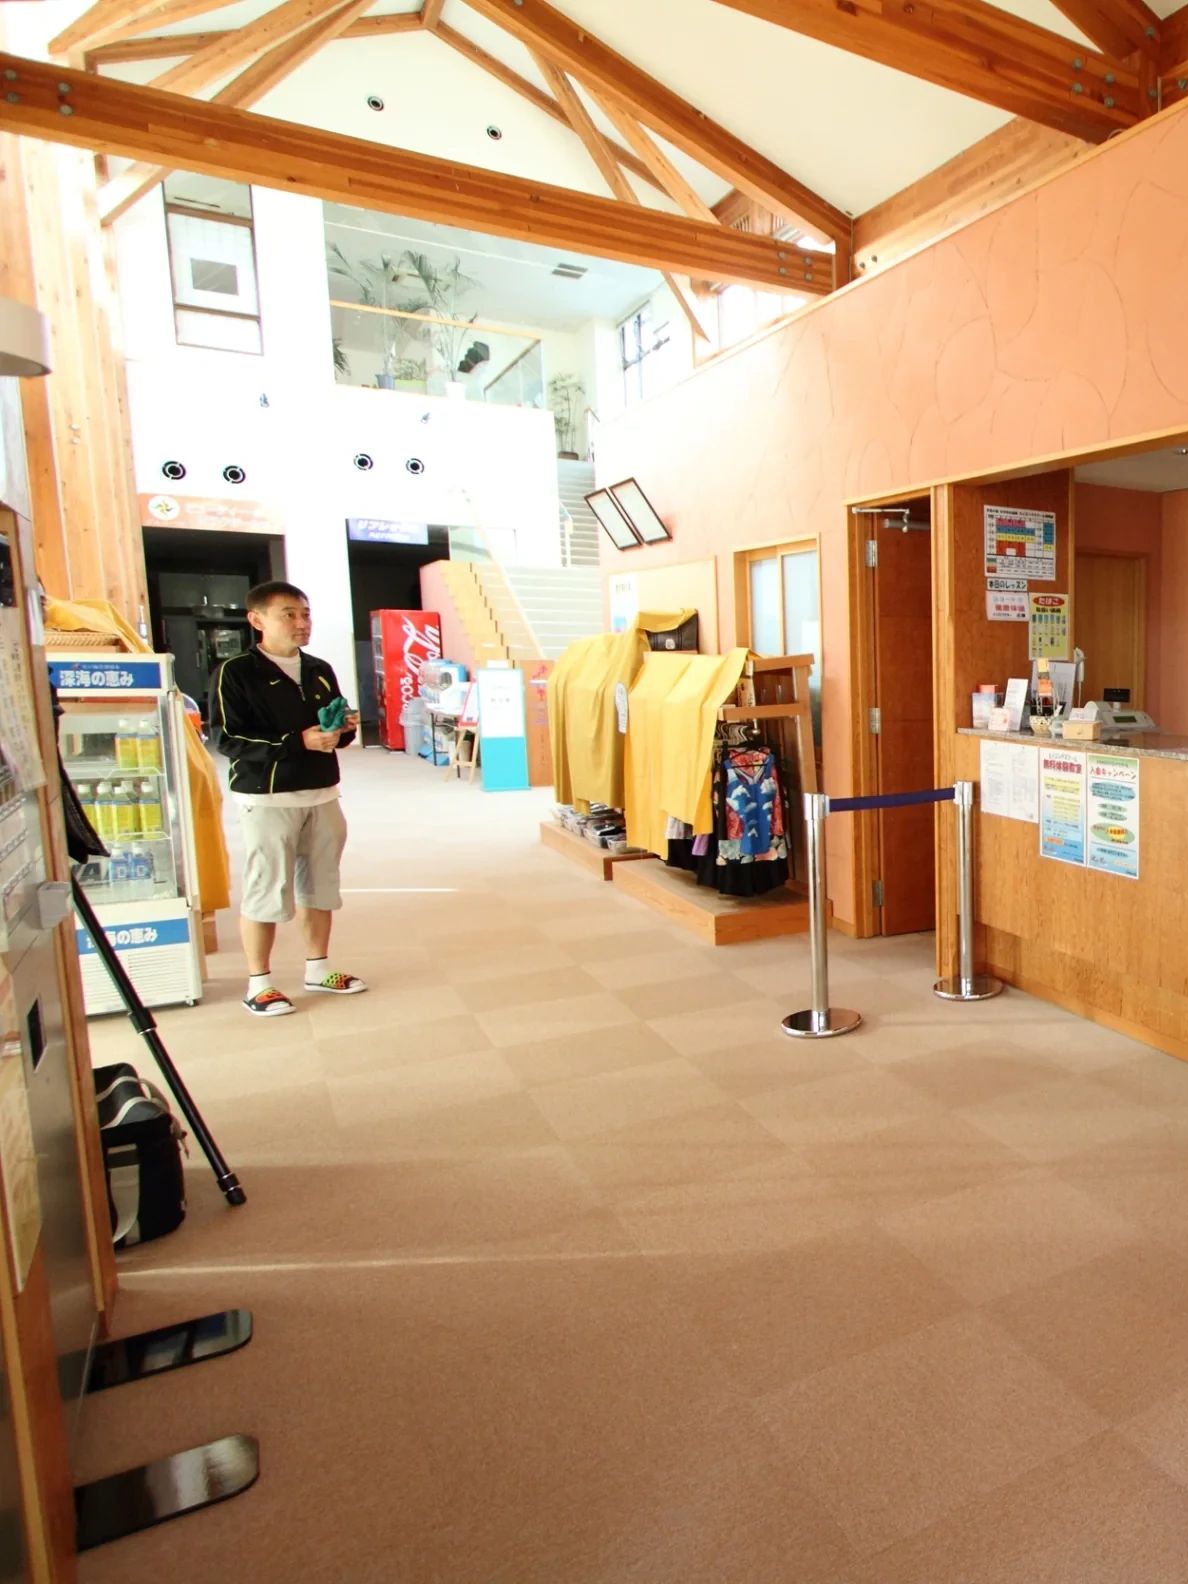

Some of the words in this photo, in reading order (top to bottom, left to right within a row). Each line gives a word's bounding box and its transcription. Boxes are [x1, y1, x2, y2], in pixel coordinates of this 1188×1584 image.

[59, 670, 134, 688] 深海の恵み
